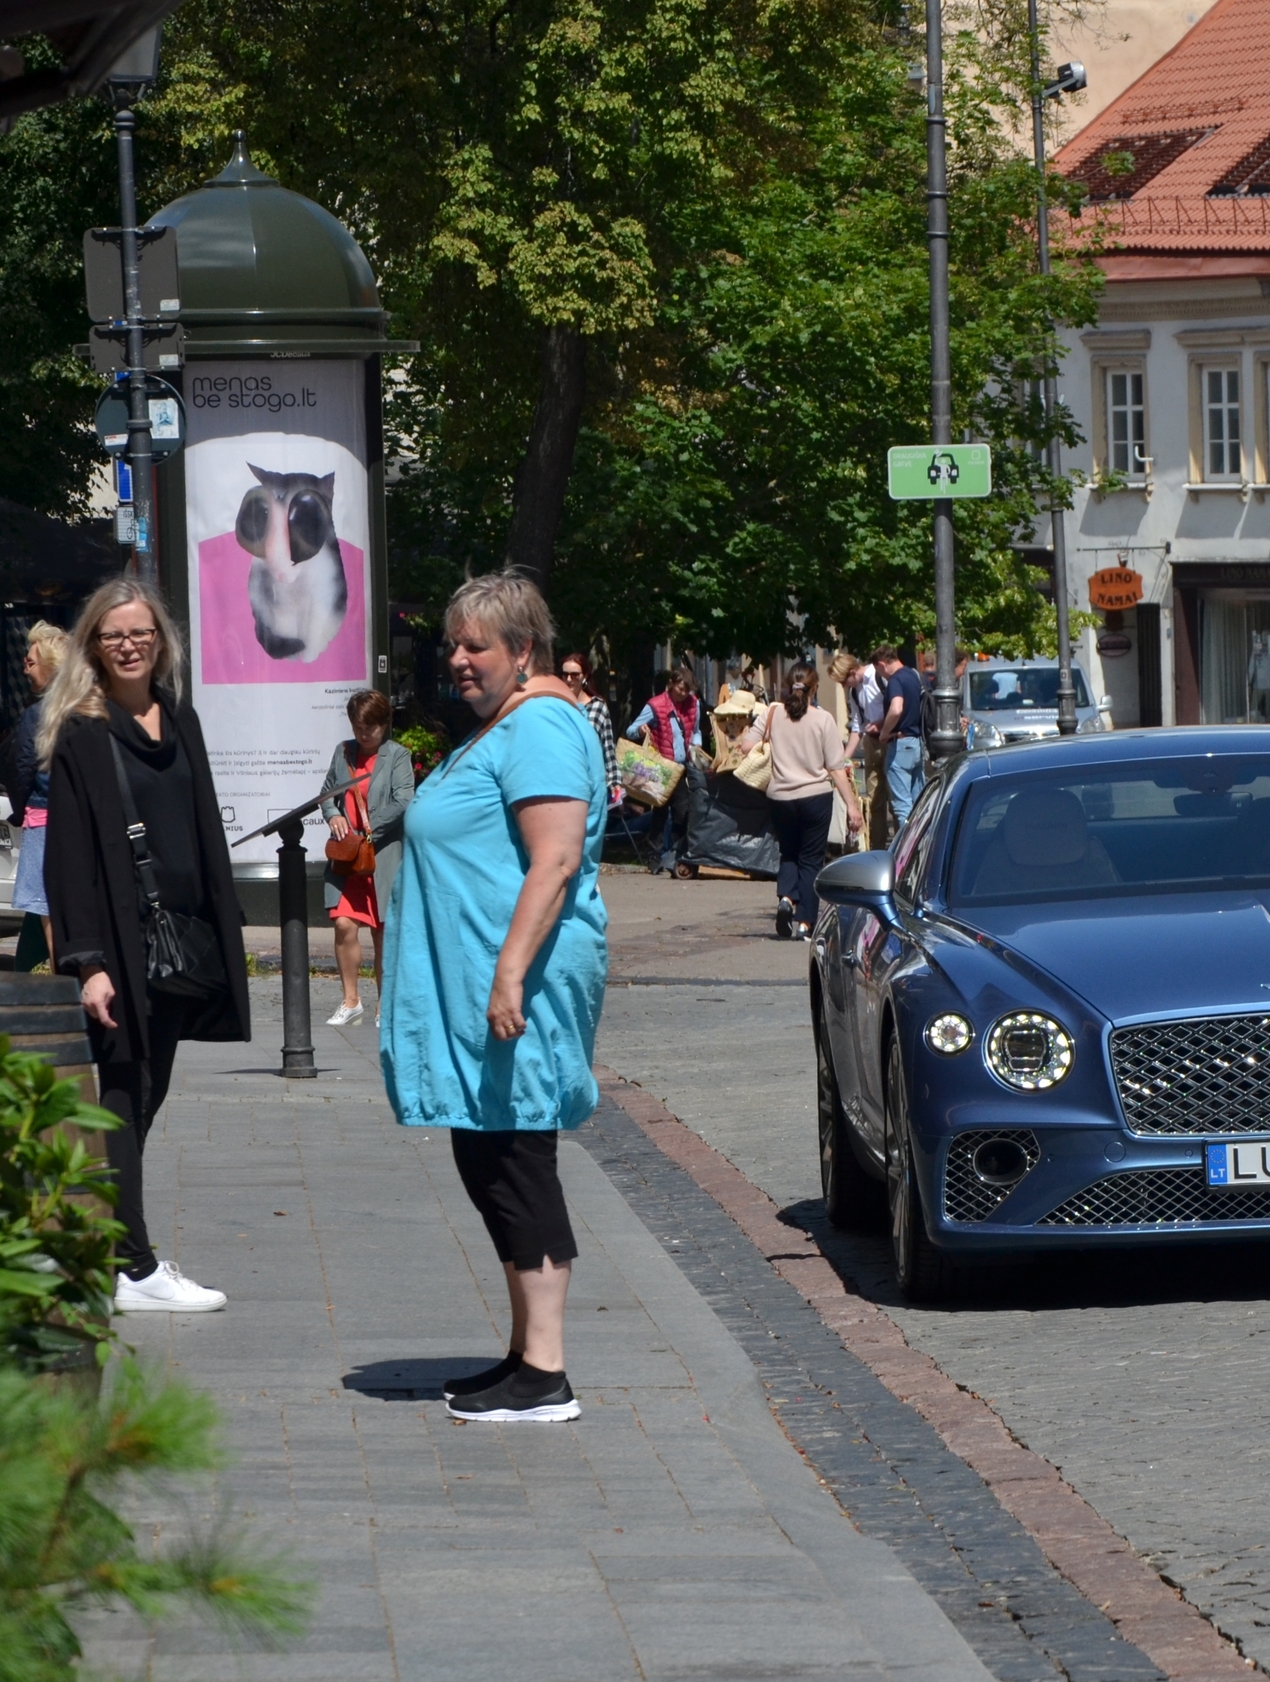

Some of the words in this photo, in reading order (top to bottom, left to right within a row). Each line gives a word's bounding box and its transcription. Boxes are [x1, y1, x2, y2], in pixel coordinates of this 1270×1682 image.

[192, 376, 272, 392] menas
[192, 390, 221, 408] be
[228, 388, 317, 413] stogo.lt
[1101, 573, 1133, 584] LINO
[1097, 592, 1139, 606] NAMAI
[302, 818, 325, 826] caux
[1210, 1168, 1226, 1179] LT
